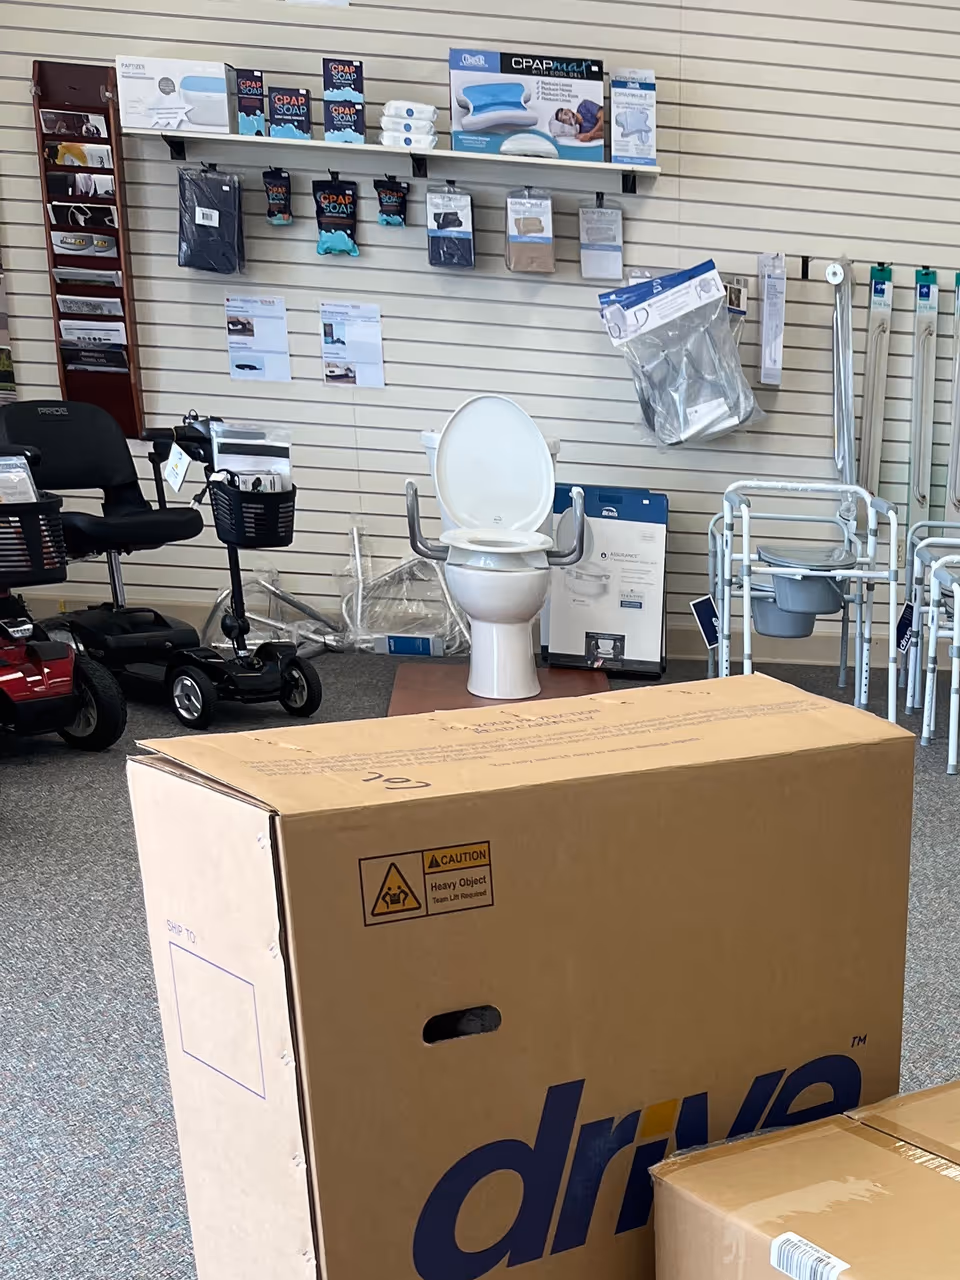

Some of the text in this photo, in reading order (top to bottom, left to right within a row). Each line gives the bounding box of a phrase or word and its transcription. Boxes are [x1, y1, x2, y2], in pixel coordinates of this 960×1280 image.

[331, 64, 356, 74] CPAP
[333, 72, 357, 81] SOAP
[240, 80, 262, 88] CPAP
[274, 95, 306, 106] CPAP
[276, 104, 307, 115] SOAP
[332, 106, 356, 115] CPAP
[334, 113, 358, 122] SOAP
[320, 194, 353, 205] CPAP
[323, 203, 354, 213] SOAP
[440, 849, 487, 866] CAUTION
[430, 875, 487, 893] Heavy Object
[432, 889, 487, 904] Team Lift Required
[167, 919, 183, 937] SHIP
